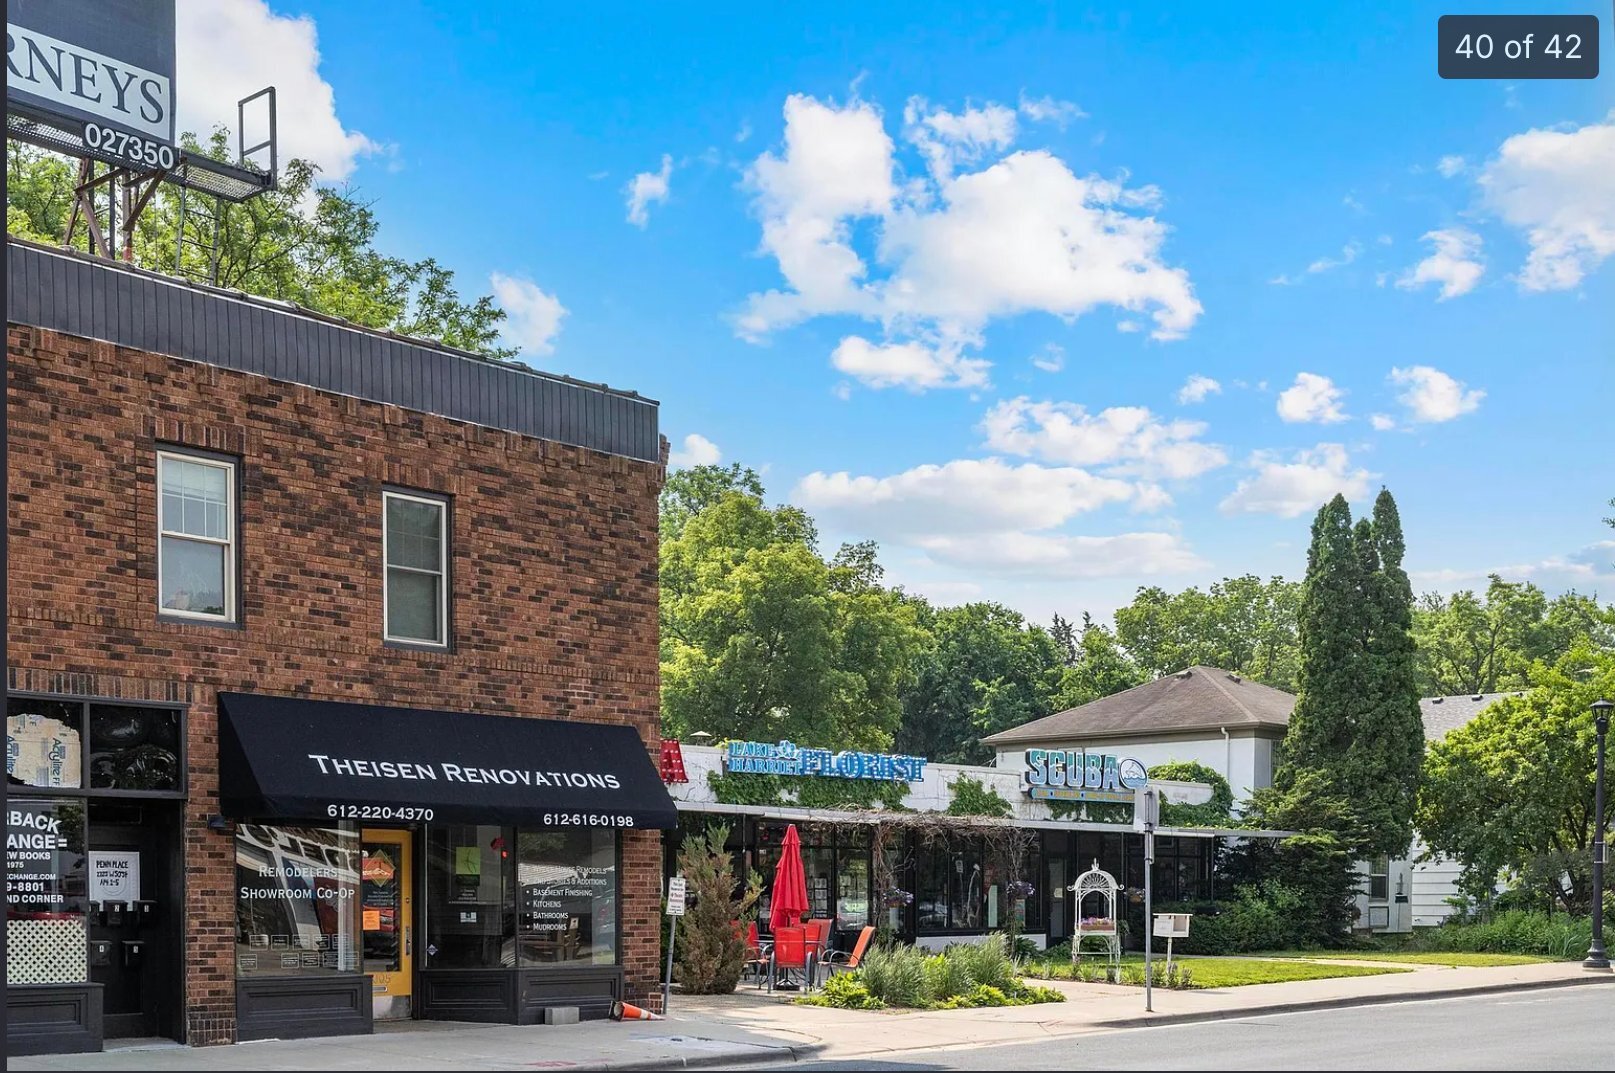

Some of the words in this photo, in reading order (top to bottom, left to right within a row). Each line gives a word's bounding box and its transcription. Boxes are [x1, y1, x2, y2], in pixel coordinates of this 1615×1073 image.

[84, 122, 175, 170] 027350
[730, 741, 776, 757] LAKE
[48, 737, 64, 776] Acrylite
[730, 756, 802, 775] HARRIET
[800, 748, 928, 782] FLORIST
[1025, 747, 1121, 790] SCUBA
[308, 754, 437, 780] THEISEN
[440, 762, 621, 790] RENOVATIONS
[327, 804, 434, 821] 612-220-4370
[543, 813, 634, 828] 612-616-0198
[20, 851, 51, 861] BOOKS
[7, 861, 25, 869] 1975
[258, 865, 338, 878] REMODELERS
[7, 881, 45, 893] 9-8801
[240, 886, 312, 899] SHOWROOM
[316, 887, 356, 899] CO-OP
[532, 888, 564, 896] BASEMENT
[564, 888, 593, 897] FINISHING
[21, 894, 65, 904] CORNER
[532, 900, 562, 908] KITCHENS
[532, 911, 569, 920] BATHROOMS
[532, 923, 568, 931] MUDROOMS
